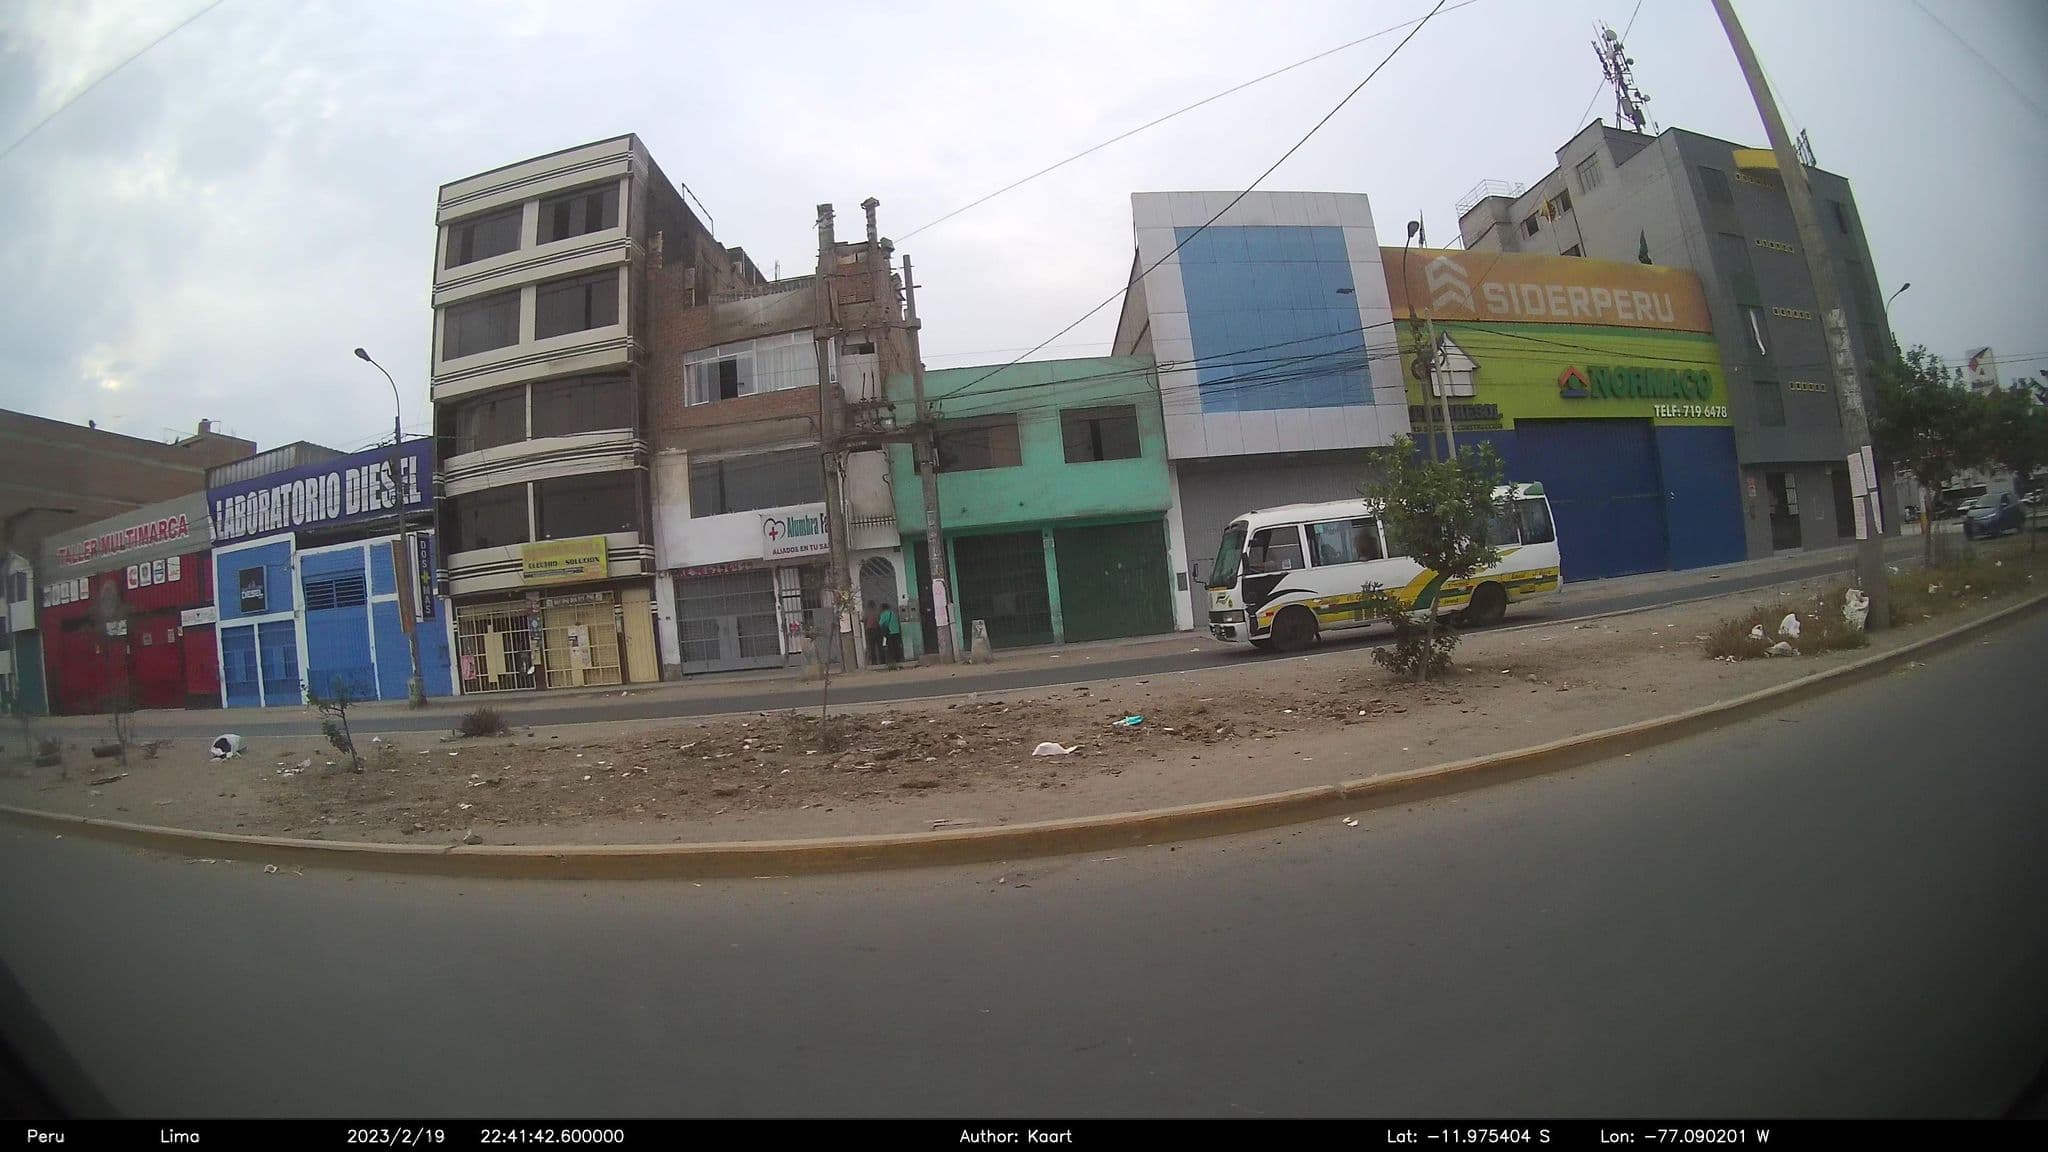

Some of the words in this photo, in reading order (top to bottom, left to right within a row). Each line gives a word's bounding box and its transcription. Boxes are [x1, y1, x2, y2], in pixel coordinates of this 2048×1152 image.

[1483, 282, 1675, 323] SIDERPERU
[1587, 365, 1713, 400] NORMACO
[1654, 404, 1681, 418] TELF:
[1682, 405, 1702, 418] 719
[1704, 406, 1728, 418] 6478
[217, 472, 340, 540] LABORATORIO
[57, 539, 98, 566] TALLER
[99, 513, 189, 558] MULTIMARCA
[820, 513, 829, 535] Fa
[420, 541, 428, 568] DOS
[772, 546, 799, 556] ALIADOS
[810, 544, 819, 552] TU
